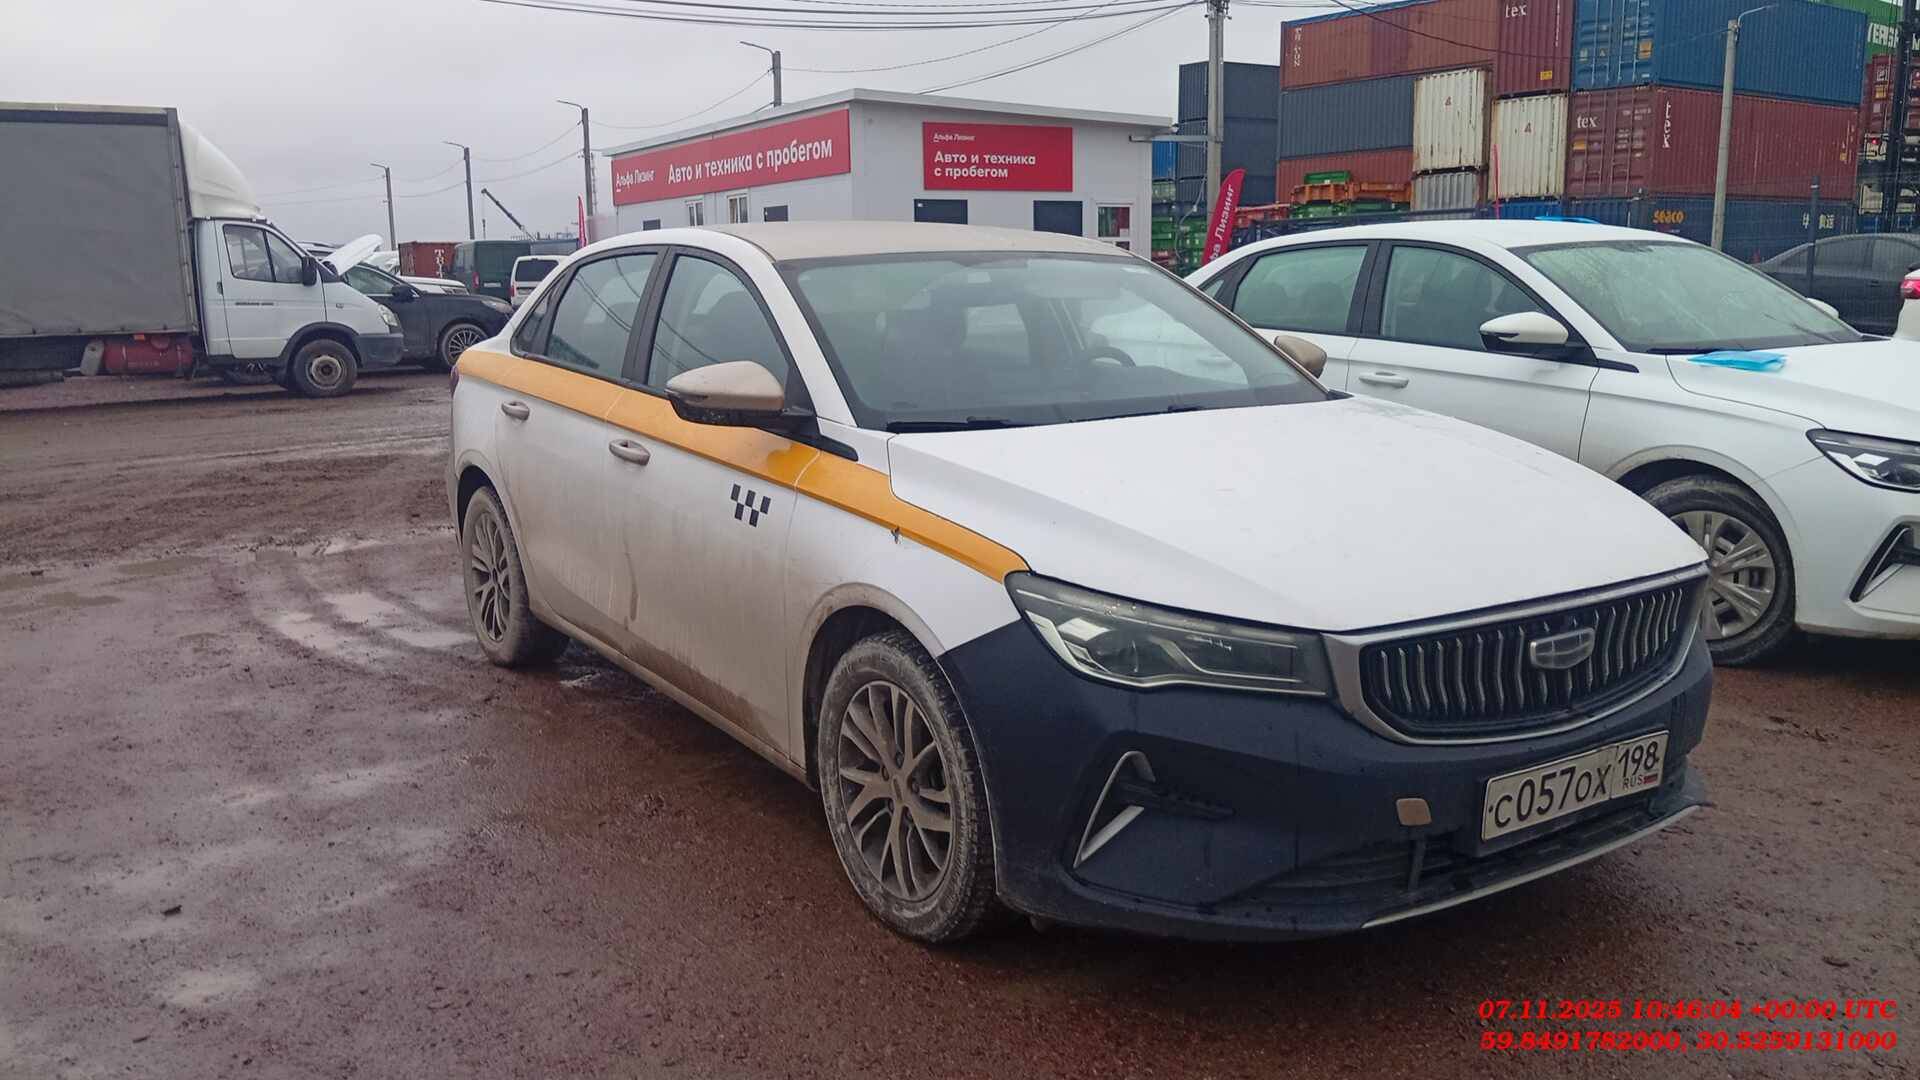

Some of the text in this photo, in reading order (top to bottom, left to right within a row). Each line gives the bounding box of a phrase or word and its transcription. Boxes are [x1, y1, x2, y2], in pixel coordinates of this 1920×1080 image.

[1576, 115, 1598, 128] tex
[1661, 101, 1672, 148] tex
[667, 138, 833, 185] Авто и техника с пробегом
[934, 151, 1036, 165] Авто и техника
[934, 166, 1008, 179] с пробегом
[1215, 184, 1234, 240] Лизинг
[1617, 741, 1659, 777] 198
[1621, 774, 1643, 789] RUS
